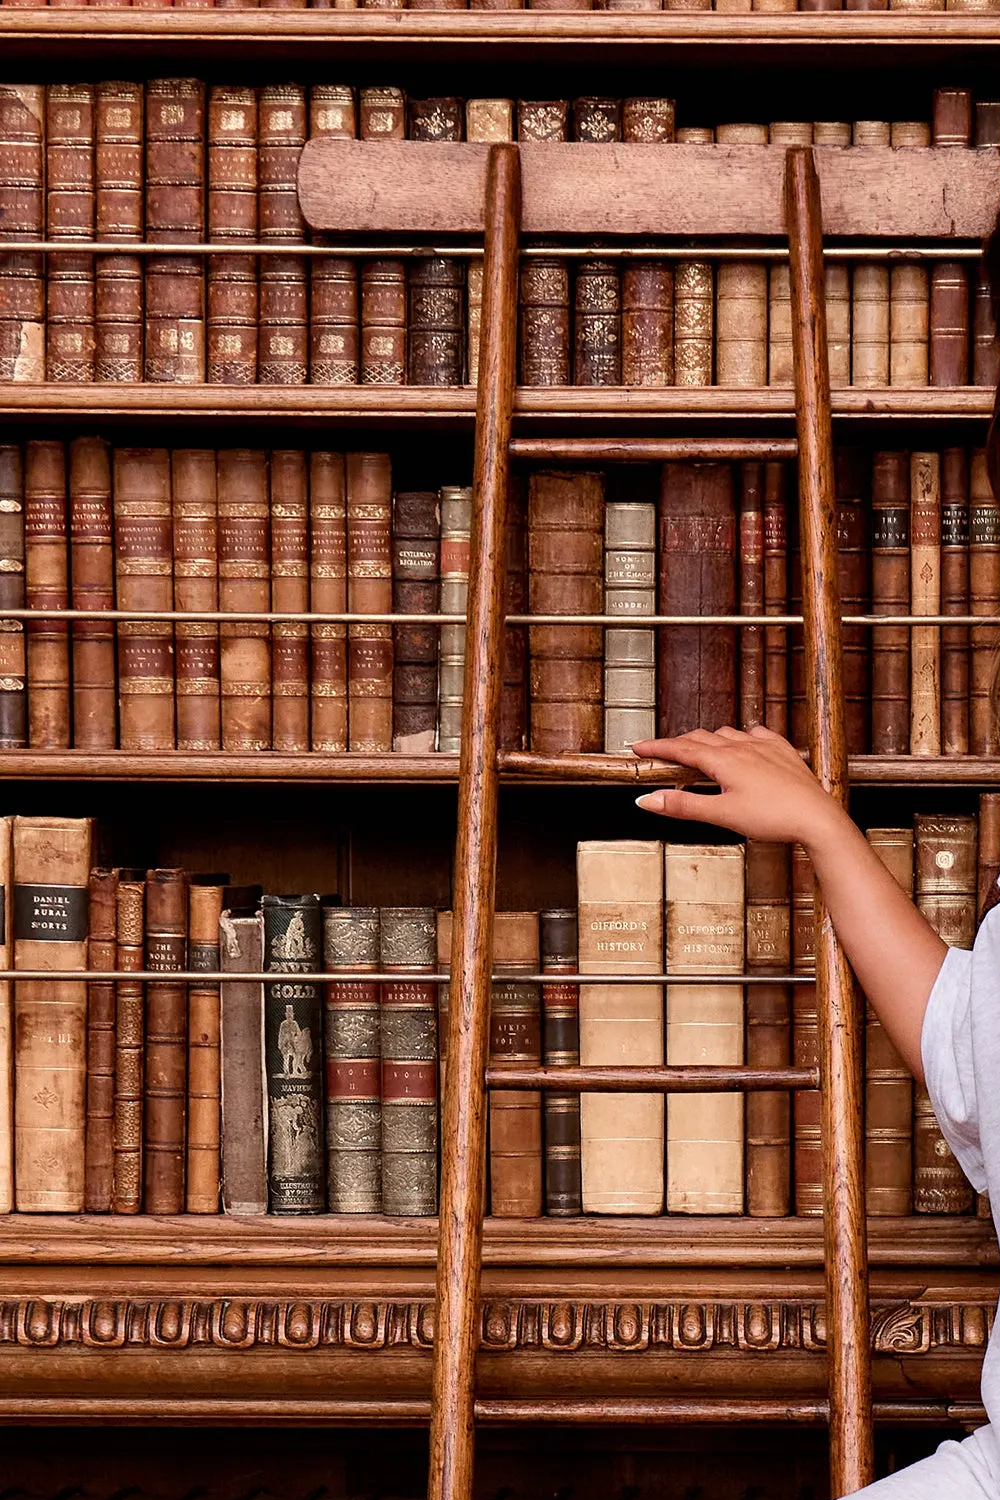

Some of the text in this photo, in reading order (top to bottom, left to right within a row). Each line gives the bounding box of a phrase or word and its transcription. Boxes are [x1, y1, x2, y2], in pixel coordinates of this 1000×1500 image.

[33, 896, 70, 904] DANIEL
[591, 921, 647, 930] GIFFORD'S
[678, 925, 734, 935] GIFFORD'S
[597, 942, 644, 951] HISTORY
[684, 944, 731, 953] HISTORY
[271, 984, 316, 999] GOLD
